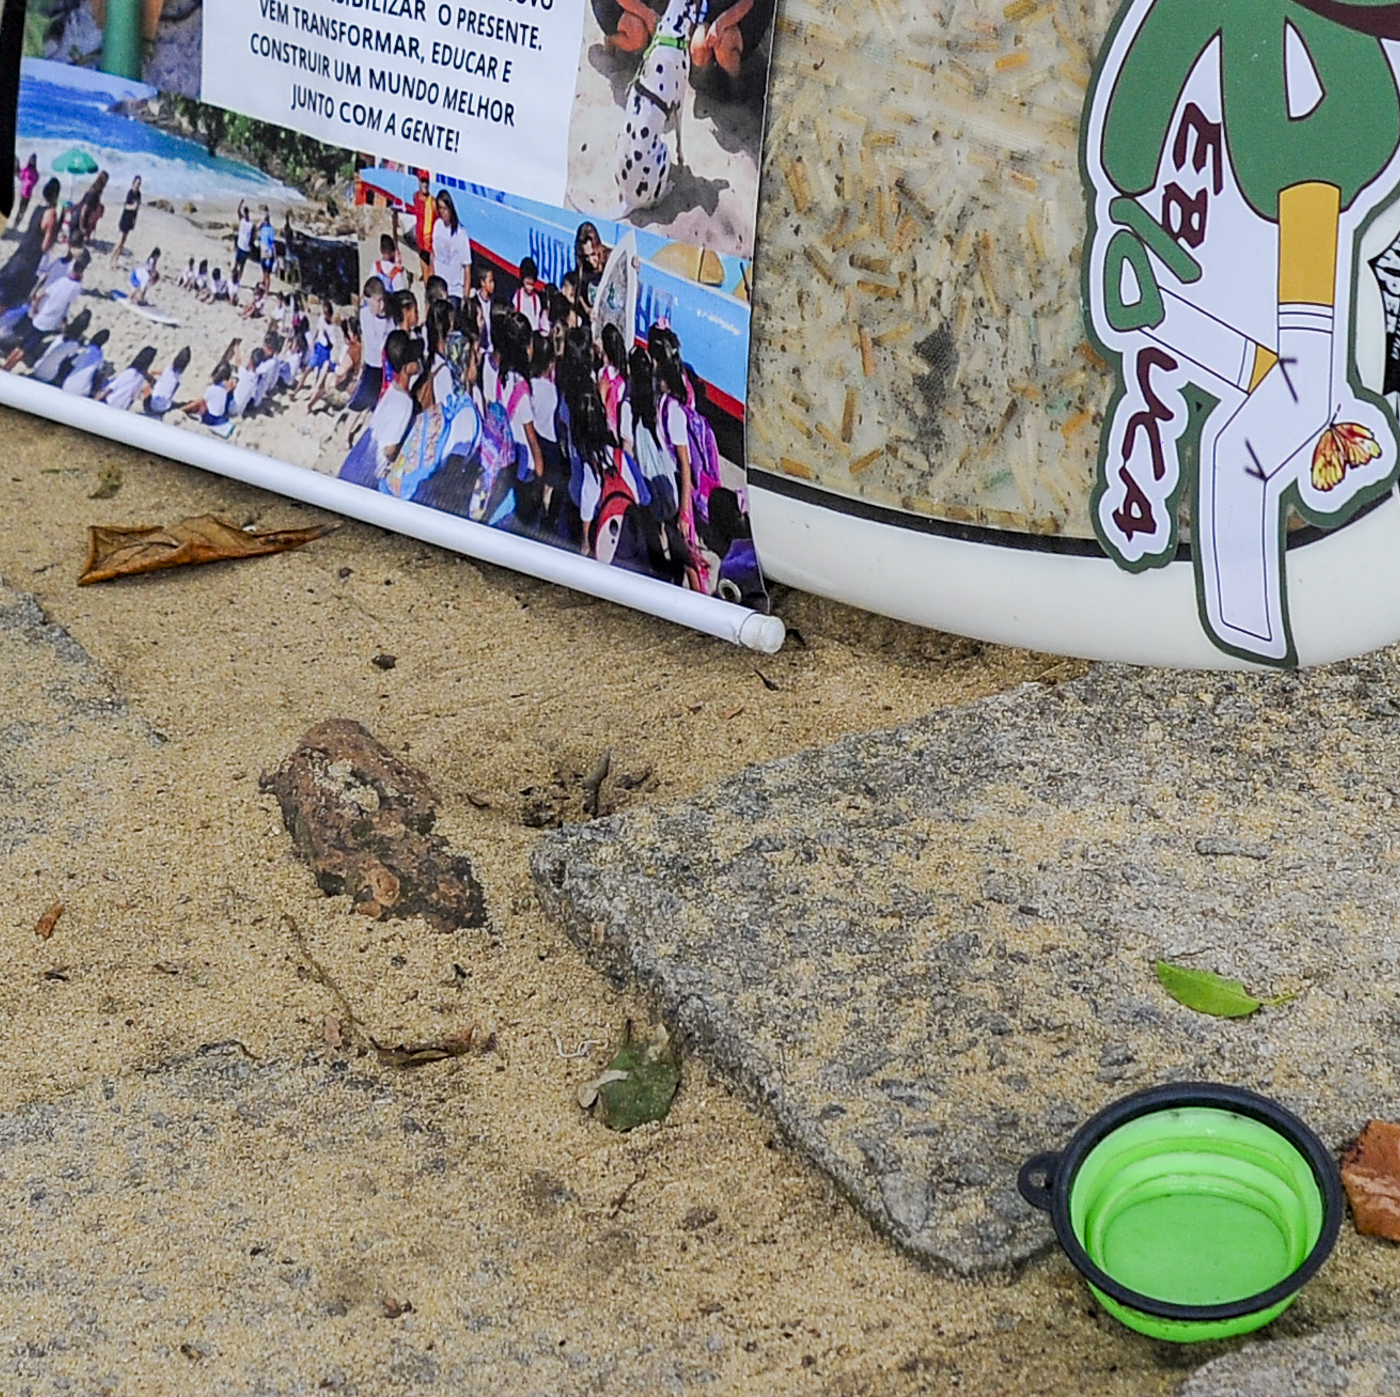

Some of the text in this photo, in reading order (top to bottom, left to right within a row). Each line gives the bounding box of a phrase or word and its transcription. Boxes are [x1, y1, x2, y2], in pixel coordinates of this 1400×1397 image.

[292, 6, 425, 64] TRANSFORMAR,
[432, 42, 498, 80] EDUCAR
[502, 60, 513, 83] E
[438, 4, 452, 26] O
[457, 8, 543, 49] PRESENTE.
[250, 33, 515, 127] CONSTRUIR UM MUNDO MELHOR
[291, 83, 461, 153] JUNTO COM A GENTE!
